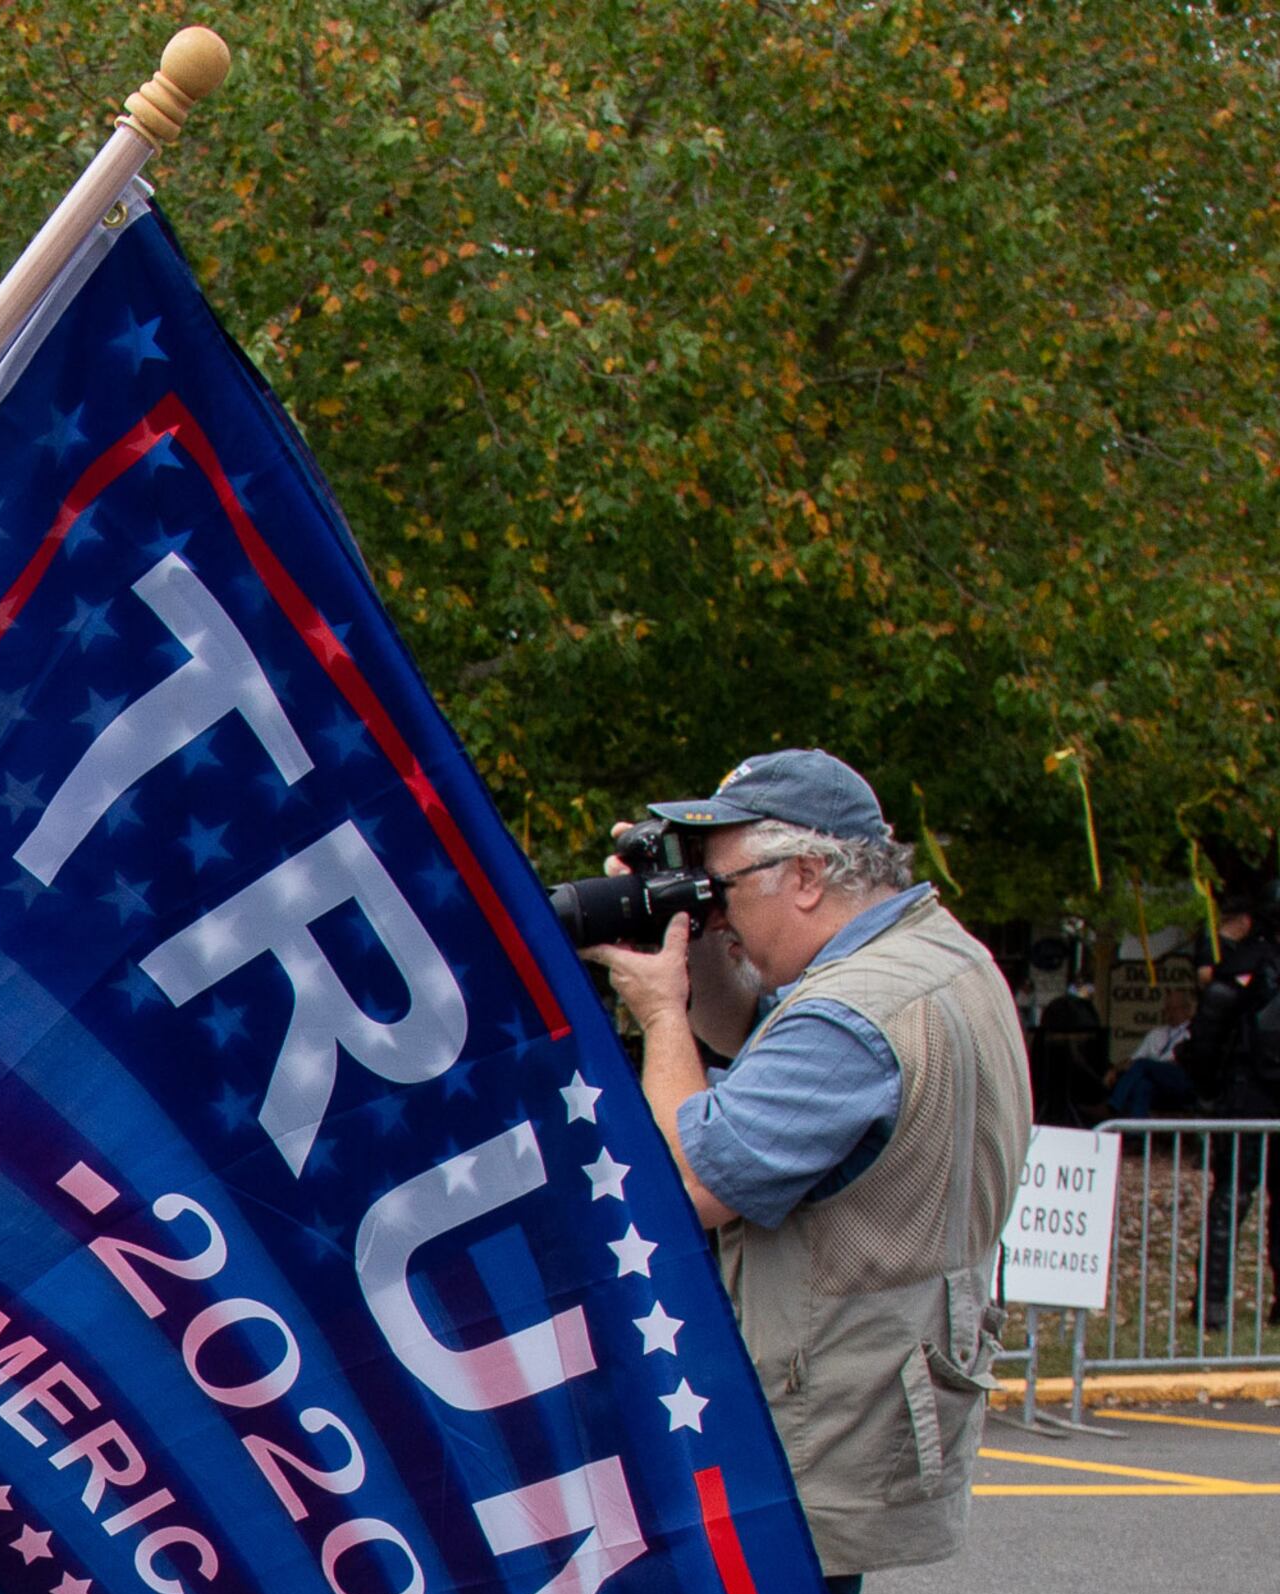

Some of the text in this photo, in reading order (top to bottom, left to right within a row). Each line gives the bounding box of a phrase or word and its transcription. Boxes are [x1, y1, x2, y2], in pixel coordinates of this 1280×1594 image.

[1019, 1162, 1096, 1193] DO NOT
[1019, 1205, 1088, 1237] CROSS
[1004, 1245, 1099, 1274] BARRICADES
